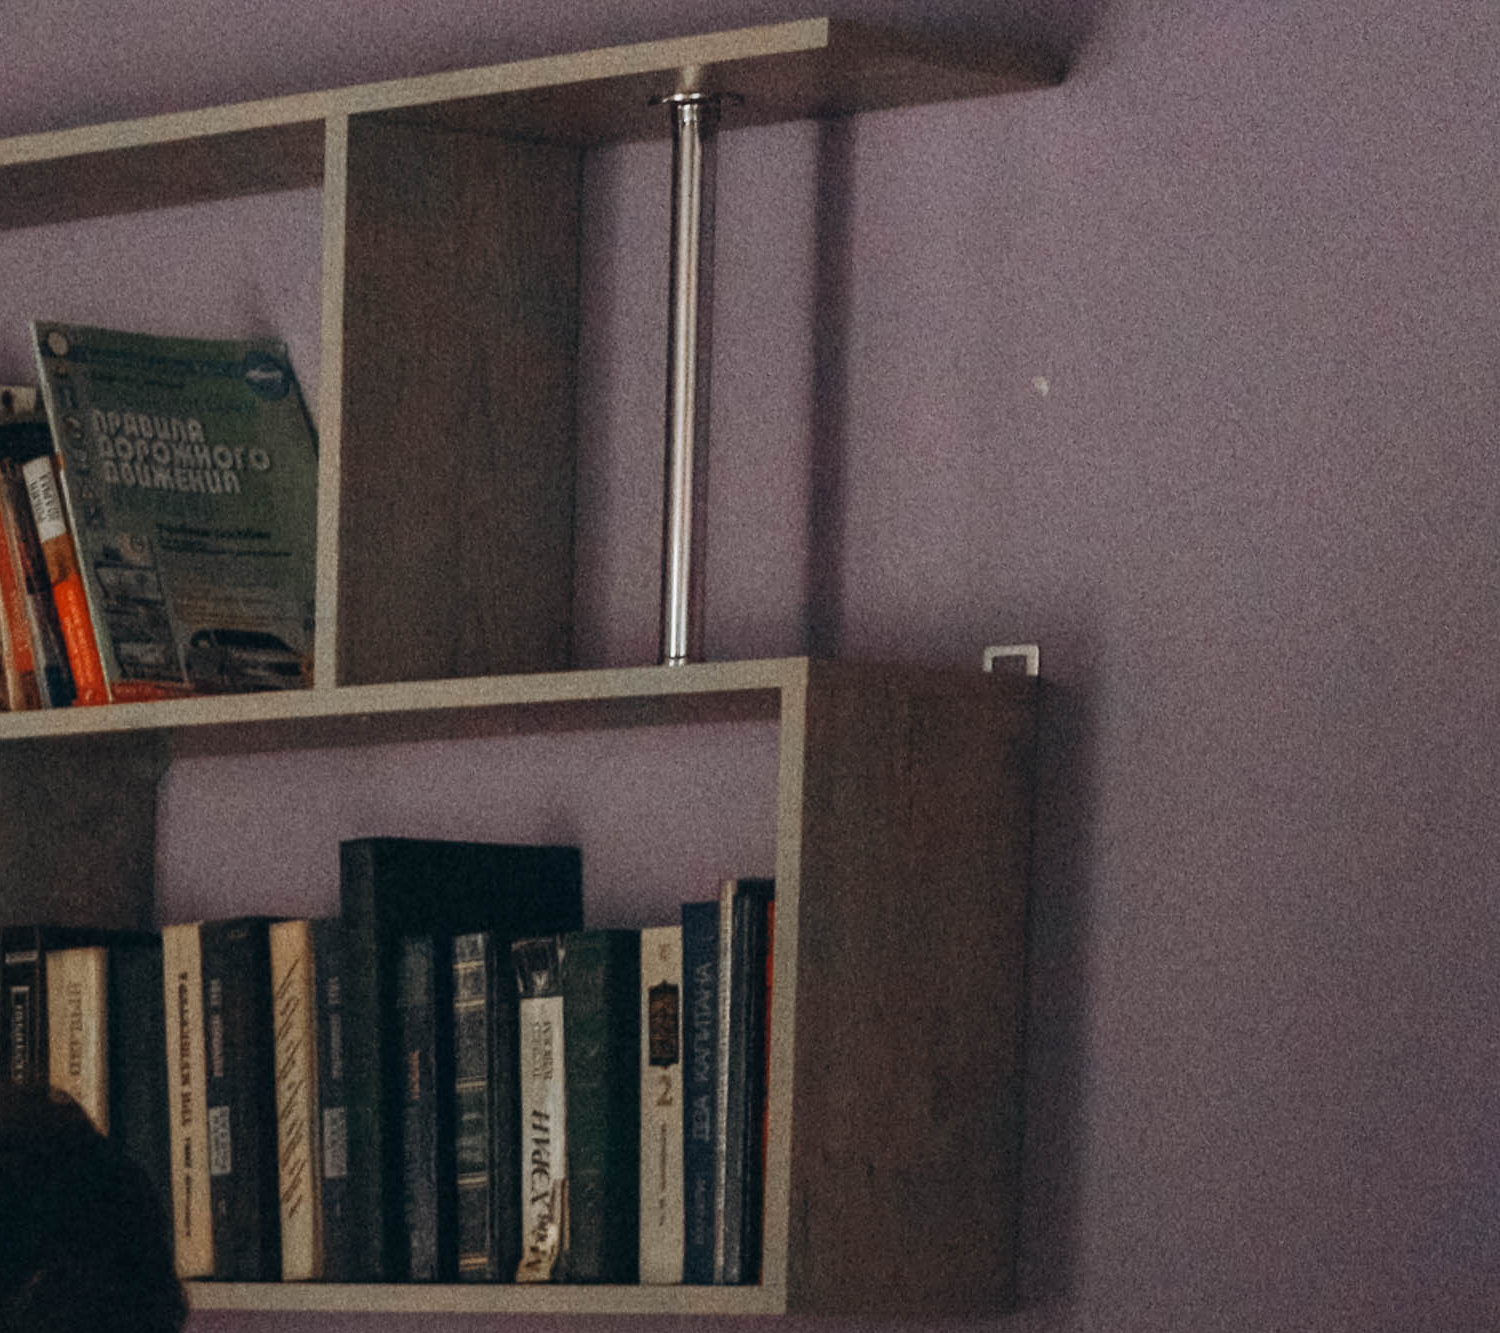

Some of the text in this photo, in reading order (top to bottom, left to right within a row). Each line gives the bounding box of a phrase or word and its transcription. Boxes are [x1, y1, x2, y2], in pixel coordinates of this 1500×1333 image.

[92, 409, 203, 442] ПРАВИЛА
[98, 435, 272, 473] ДОРОЖНОГО
[104, 460, 241, 494] ДВИЖЕНИЯ
[655, 1074, 674, 1107] 2
[530, 1108, 552, 1207] ХЭРАН
